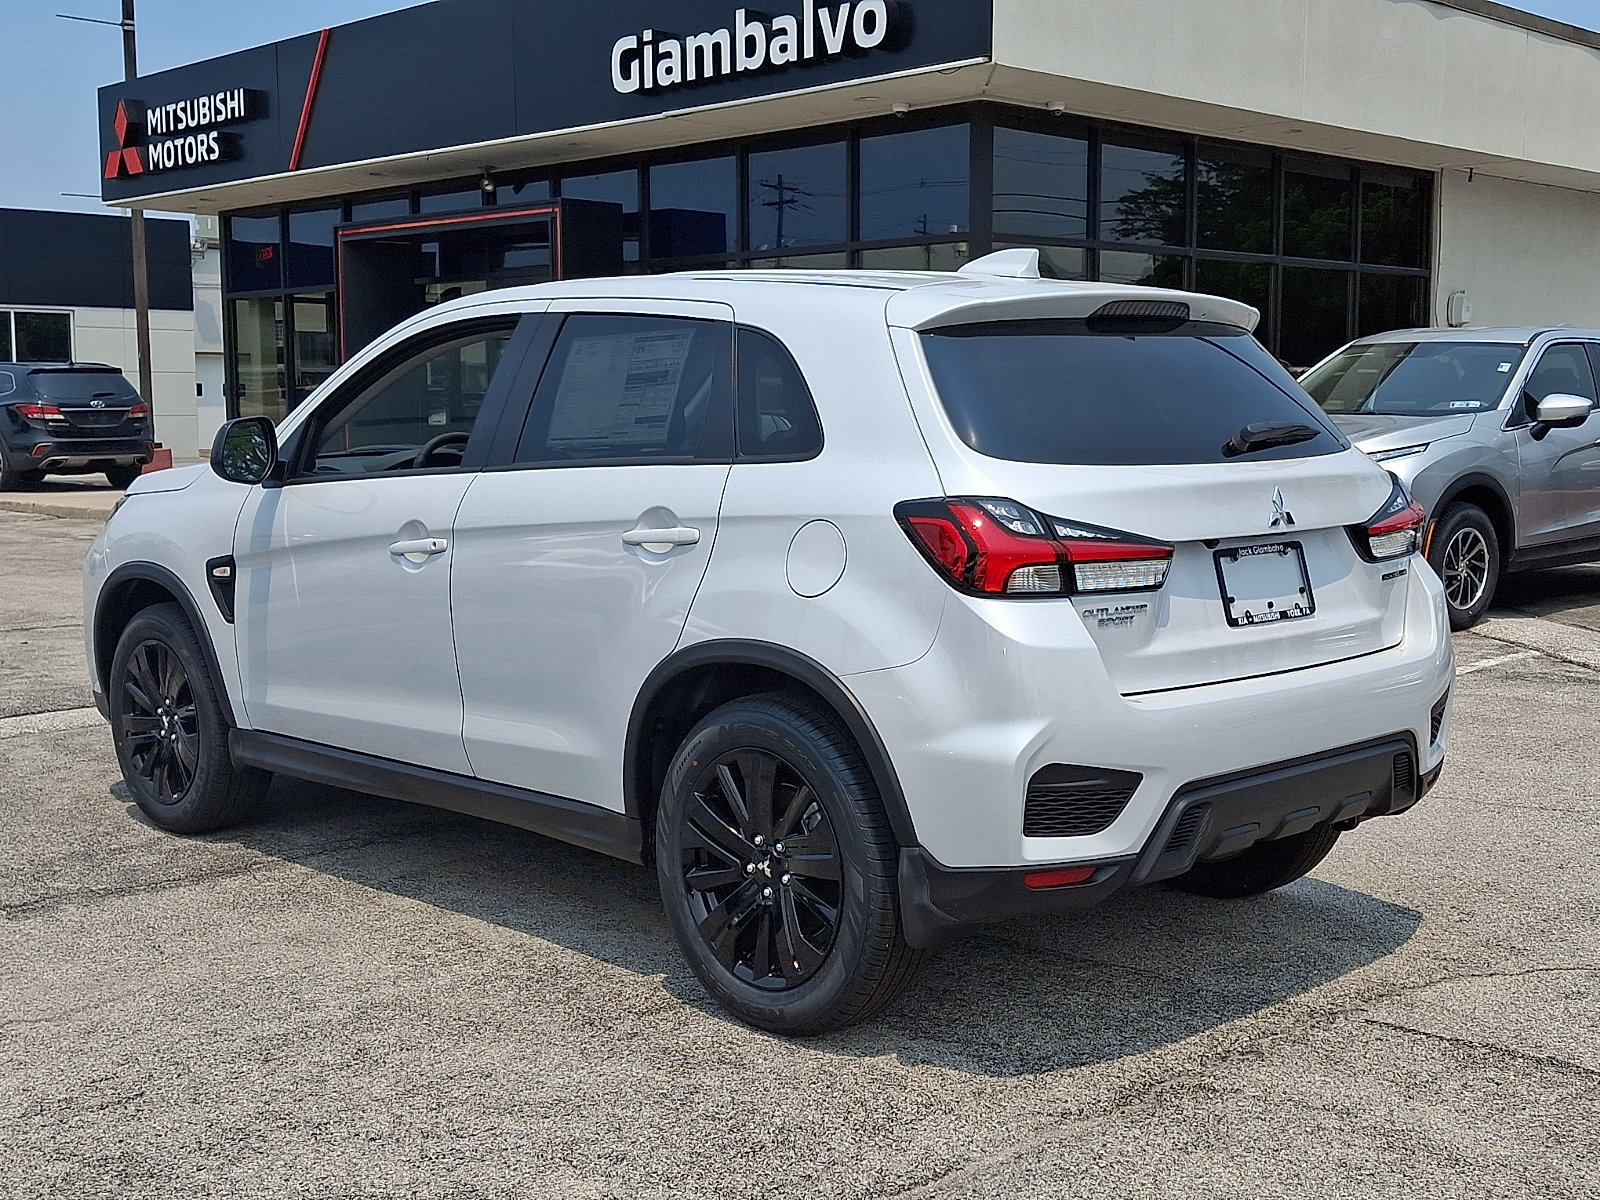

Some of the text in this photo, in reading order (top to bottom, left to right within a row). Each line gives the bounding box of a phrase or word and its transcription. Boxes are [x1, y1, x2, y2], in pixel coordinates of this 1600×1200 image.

[610, 0, 888, 93] Giambalvo
[147, 88, 245, 136] MITSUBISHI
[149, 130, 220, 171] MOTORS
[1238, 547, 1253, 557] Jack
[1082, 604, 1147, 617] OUTLANDER
[1098, 615, 1135, 628] SPORT
[1238, 616, 1249, 625] KIA
